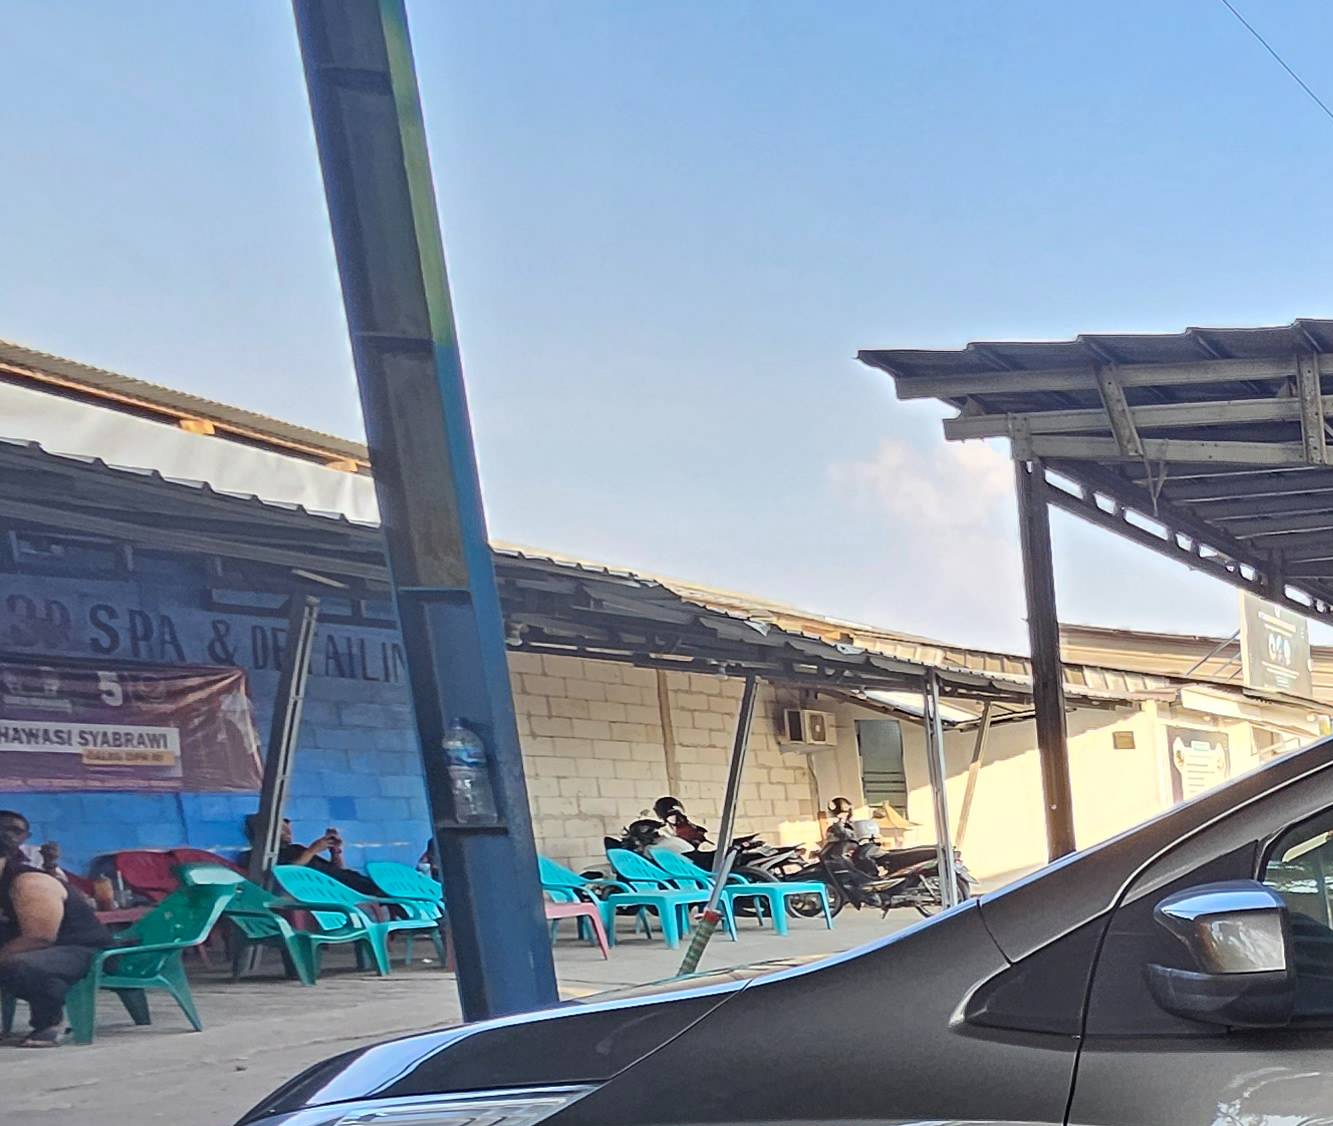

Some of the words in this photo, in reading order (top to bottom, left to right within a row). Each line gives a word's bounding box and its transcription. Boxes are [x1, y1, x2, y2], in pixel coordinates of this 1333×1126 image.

[89, 603, 187, 663] SPA
[208, 619, 236, 667] &
[97, 671, 123, 707] 5
[77, 729, 169, 750] SYABRAWI
